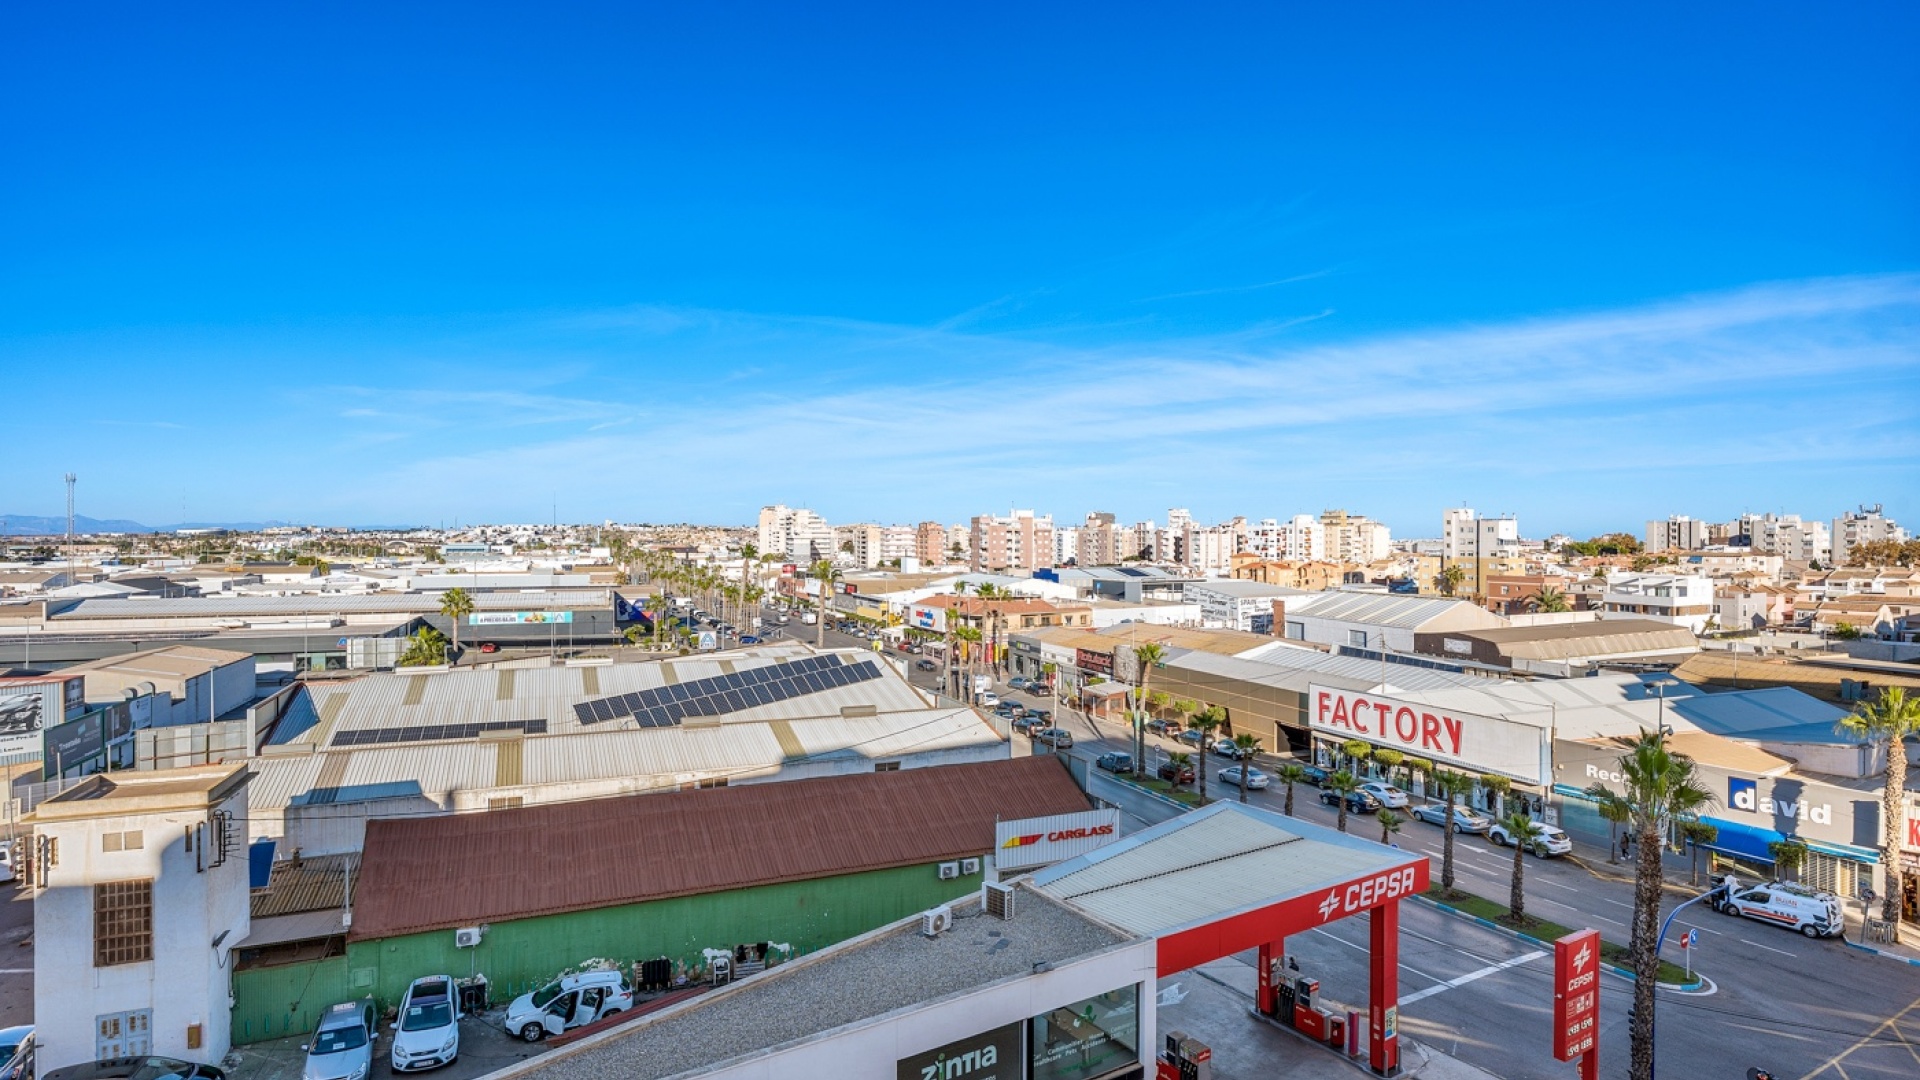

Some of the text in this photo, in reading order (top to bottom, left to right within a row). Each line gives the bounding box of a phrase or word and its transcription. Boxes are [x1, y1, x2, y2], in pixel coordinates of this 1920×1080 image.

[1318, 691, 1463, 756] FACTORY
[1734, 788, 1831, 825] david
[1047, 825, 1113, 842] CARGLASS
[1344, 866, 1415, 912] CEPSA
[1568, 970, 1595, 991] CEPSA
